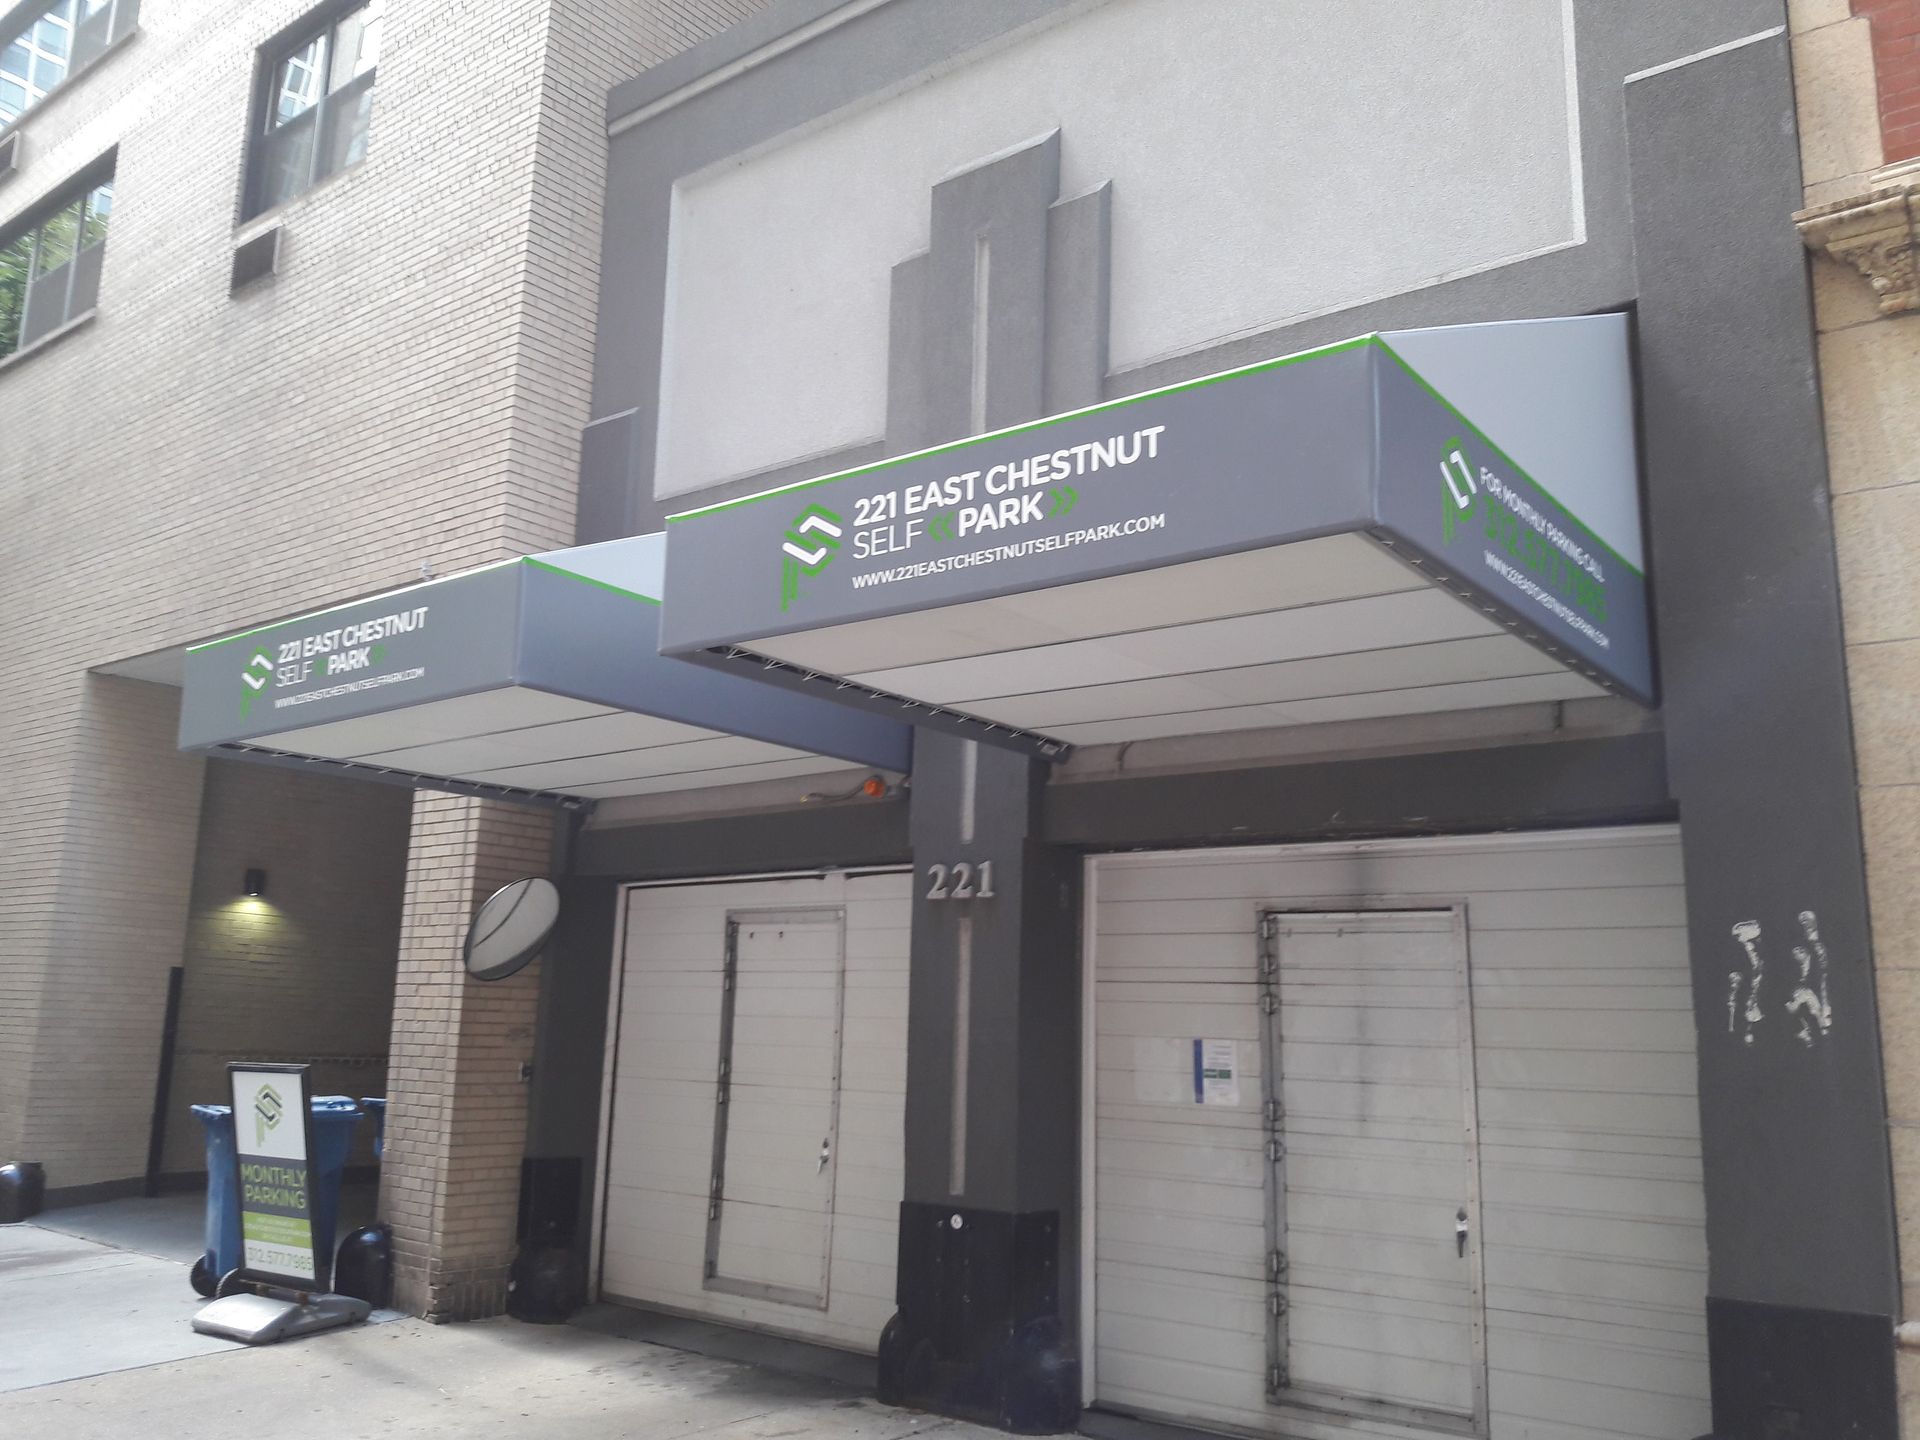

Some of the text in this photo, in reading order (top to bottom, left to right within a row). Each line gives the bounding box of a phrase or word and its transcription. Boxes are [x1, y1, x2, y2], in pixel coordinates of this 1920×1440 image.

[853, 425, 1165, 528] 221 EAST CHESTNUT
[1480, 466, 1502, 499] FOR
[852, 492, 1044, 560] SELF PARK
[852, 514, 1166, 590] WWW.221EASTCHESTNUTSELFPARK.COM
[277, 607, 429, 664] 221 EAST CHESTNUT
[275, 647, 371, 688] SELF PARK
[926, 861, 995, 899] 221
[241, 1164, 307, 1187] MONTHLY
[244, 1183, 306, 1209] PARKING
